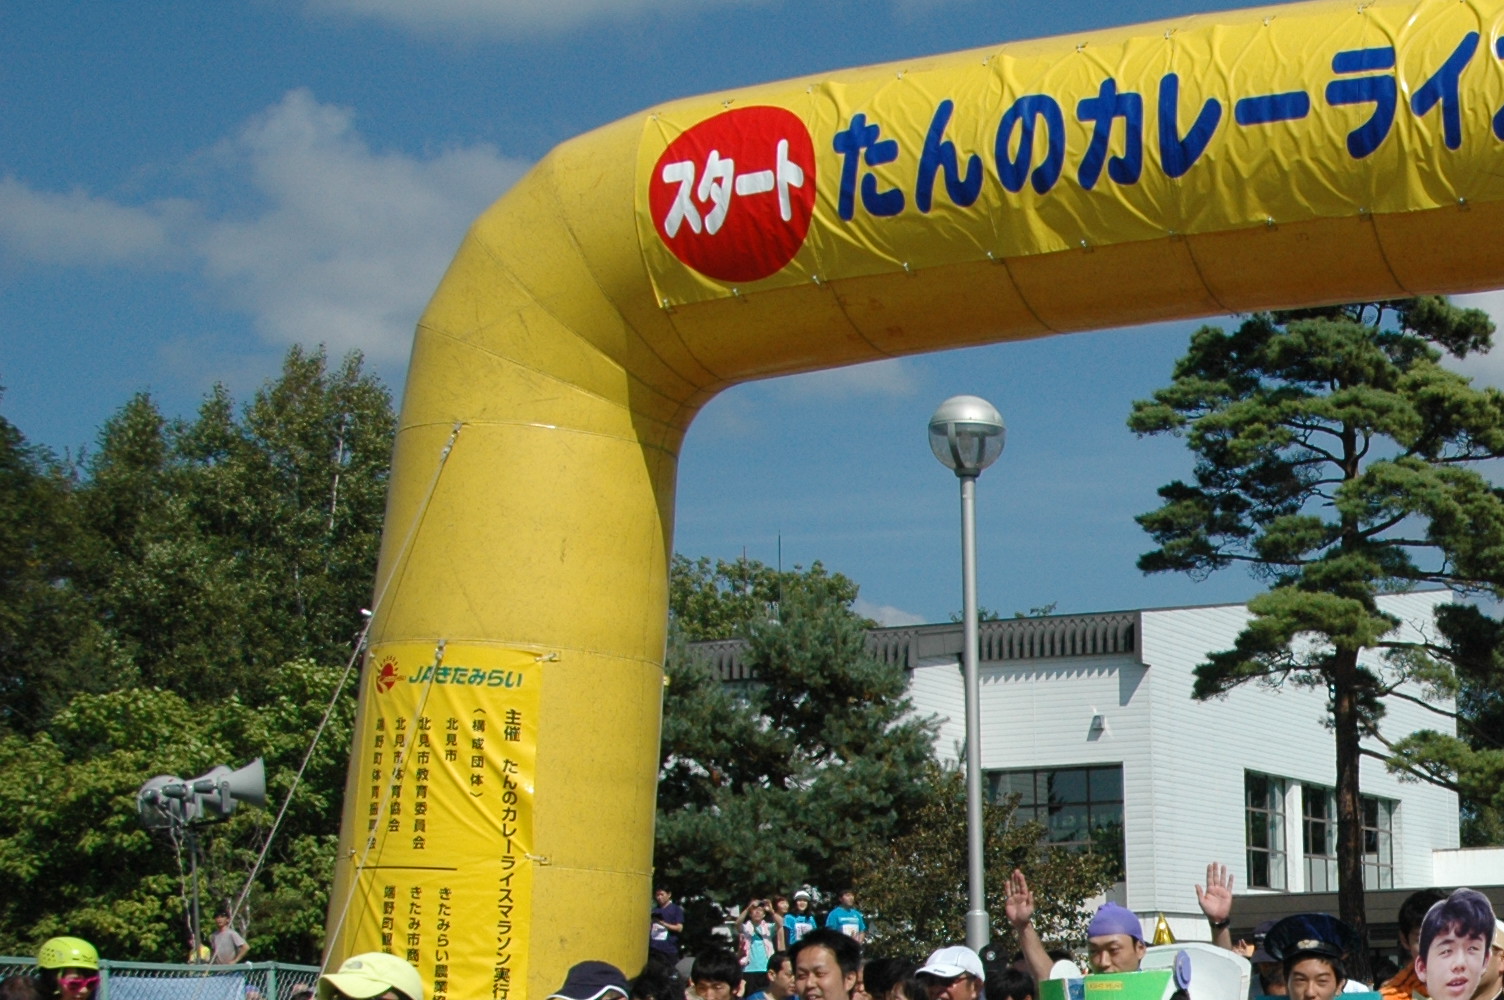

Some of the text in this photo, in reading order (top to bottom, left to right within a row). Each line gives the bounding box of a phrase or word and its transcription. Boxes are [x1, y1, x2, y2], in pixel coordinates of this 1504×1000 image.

[662, 138, 804, 238] スタート
[409, 666, 524, 688] JAきたみらい
[444, 717, 459, 762] 北見市
[504, 709, 521, 741] 主催
[388, 717, 406, 832] 北見市体育協会
[413, 716, 431, 850] 北見市教育委員会
[407, 886, 422, 967] きたみ市商
